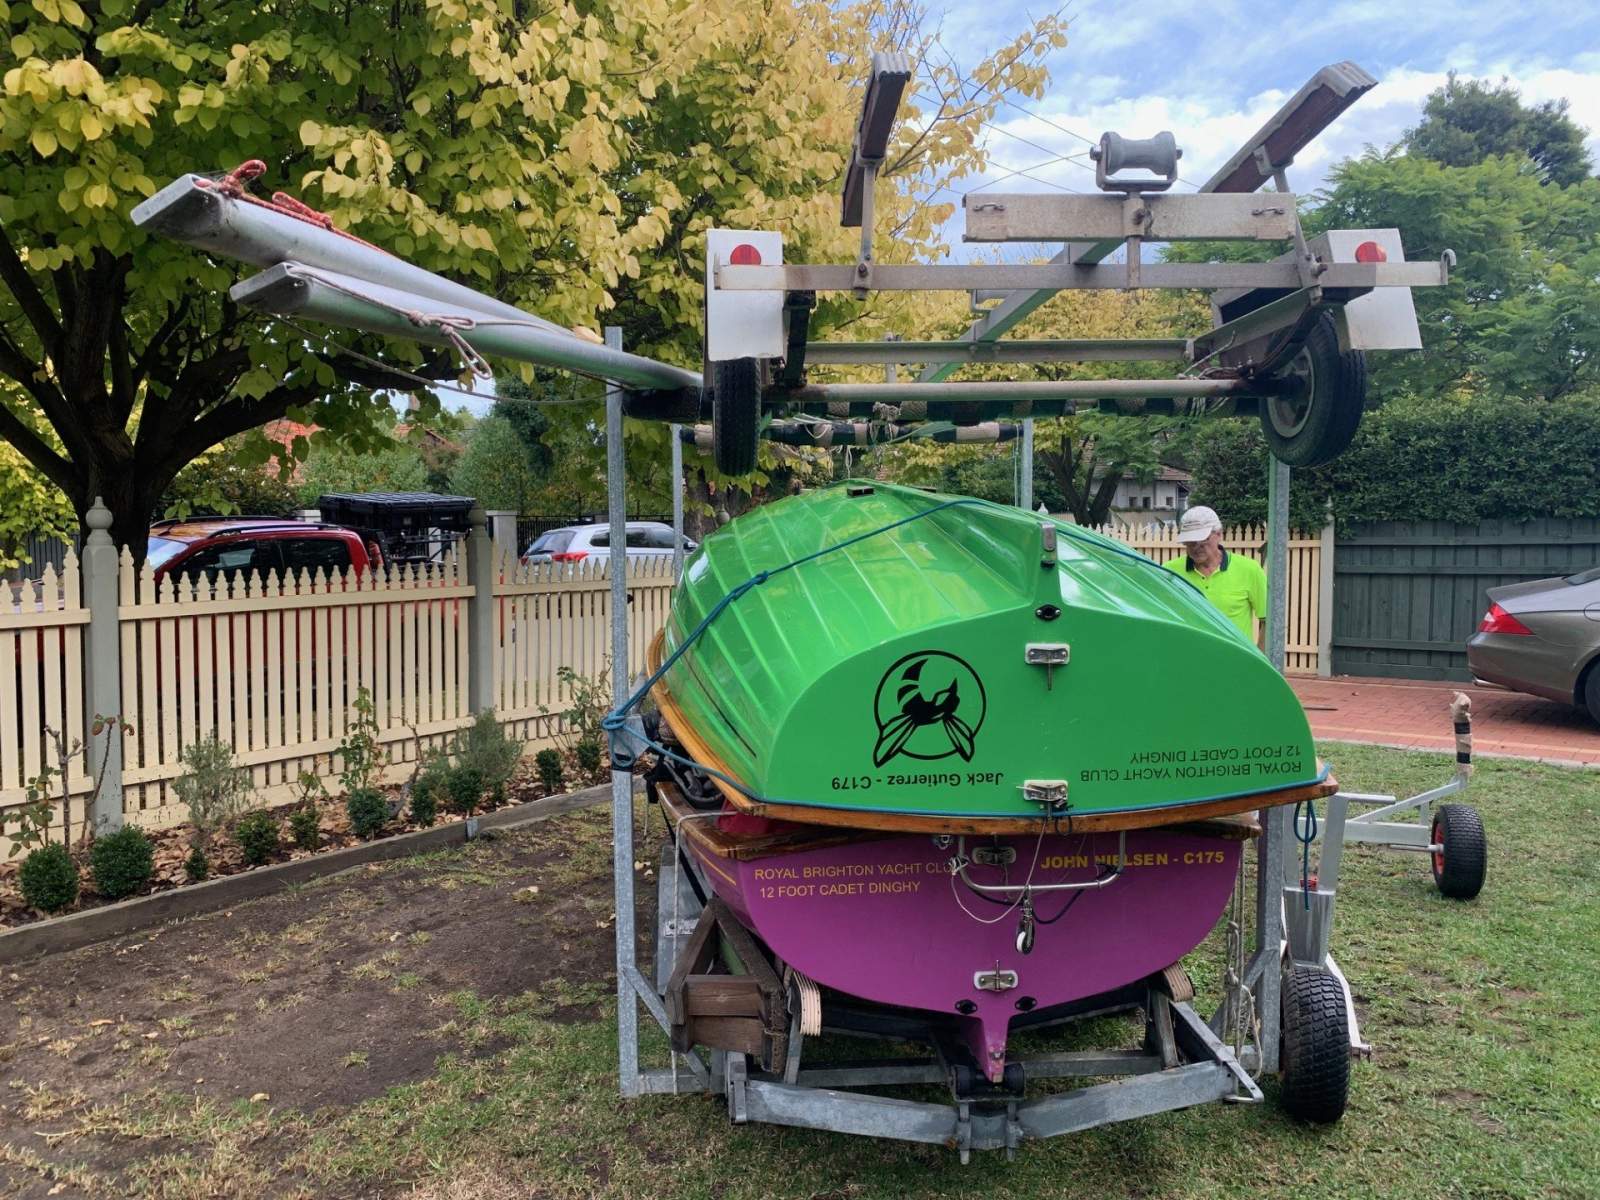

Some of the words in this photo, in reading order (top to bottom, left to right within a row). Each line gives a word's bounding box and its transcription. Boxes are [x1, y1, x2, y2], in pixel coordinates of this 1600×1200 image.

[1130, 750, 1186, 764] DINGHY
[1190, 748, 1238, 761] CADET
[1242, 746, 1282, 760] FOOT
[1286, 744, 1301, 756] 12
[1123, 767, 1170, 780] YACHT
[1176, 764, 1251, 778] BRIGHTON
[1255, 760, 1302, 774] ROYAL
[887, 773, 960, 788] Gutierrez
[966, 771, 1004, 787] Jack
[1080, 769, 1119, 782] CLUB
[831, 776, 872, 790] C179
[1040, 856, 1088, 869] JOHN
[1184, 851, 1225, 864] C175
[754, 868, 799, 880] ROYAL
[803, 864, 874, 878] BRIGHTON
[877, 862, 922, 876] YACHT
[925, 862, 956, 874] CLU
[760, 886, 775, 898] 12
[778, 885, 816, 897] FOOT
[819, 883, 865, 896] CADET
[868, 881, 921, 894] DINGHY
